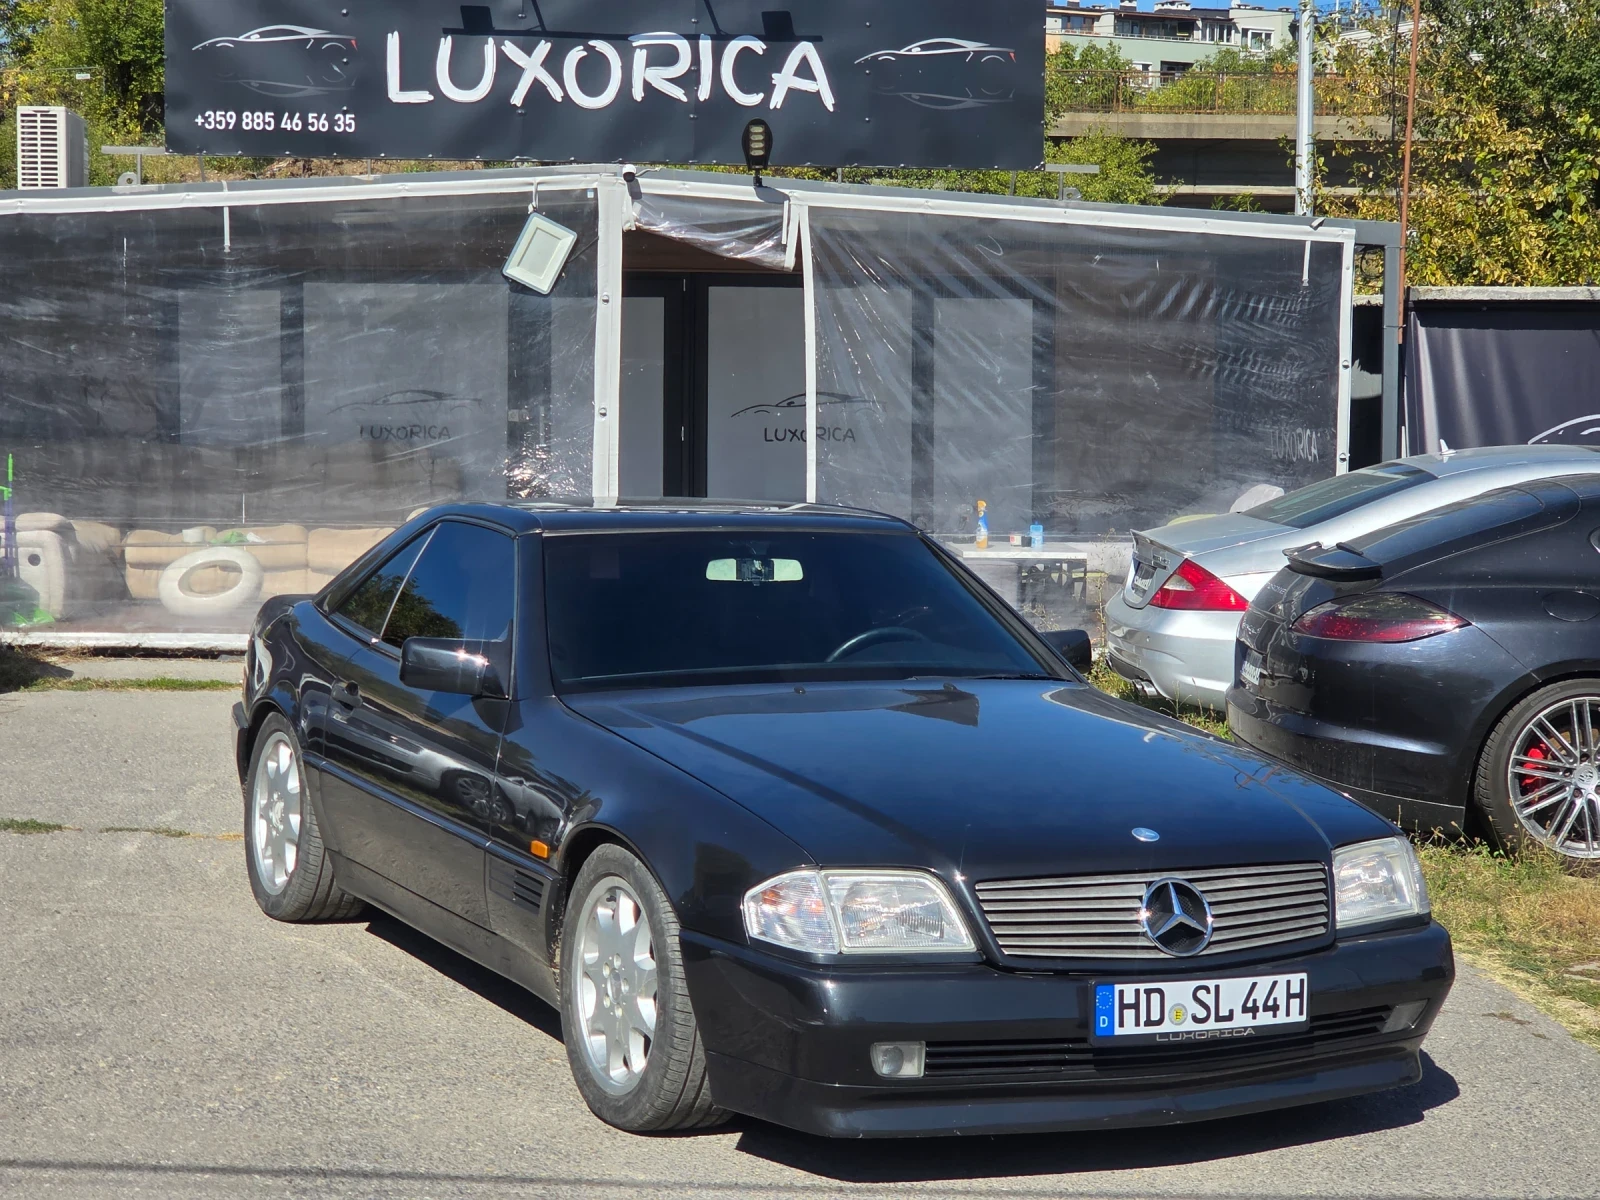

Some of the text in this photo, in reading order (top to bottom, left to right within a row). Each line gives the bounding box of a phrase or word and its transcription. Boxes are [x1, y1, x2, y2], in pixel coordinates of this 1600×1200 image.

[386, 30, 835, 112] LUXORICA
[194, 110, 356, 133] +359 885 46 56 35
[1117, 977, 1305, 1028] HD SL 44H
[1099, 1016, 1109, 1028] D
[1156, 1027, 1256, 1042] LUXORICA
